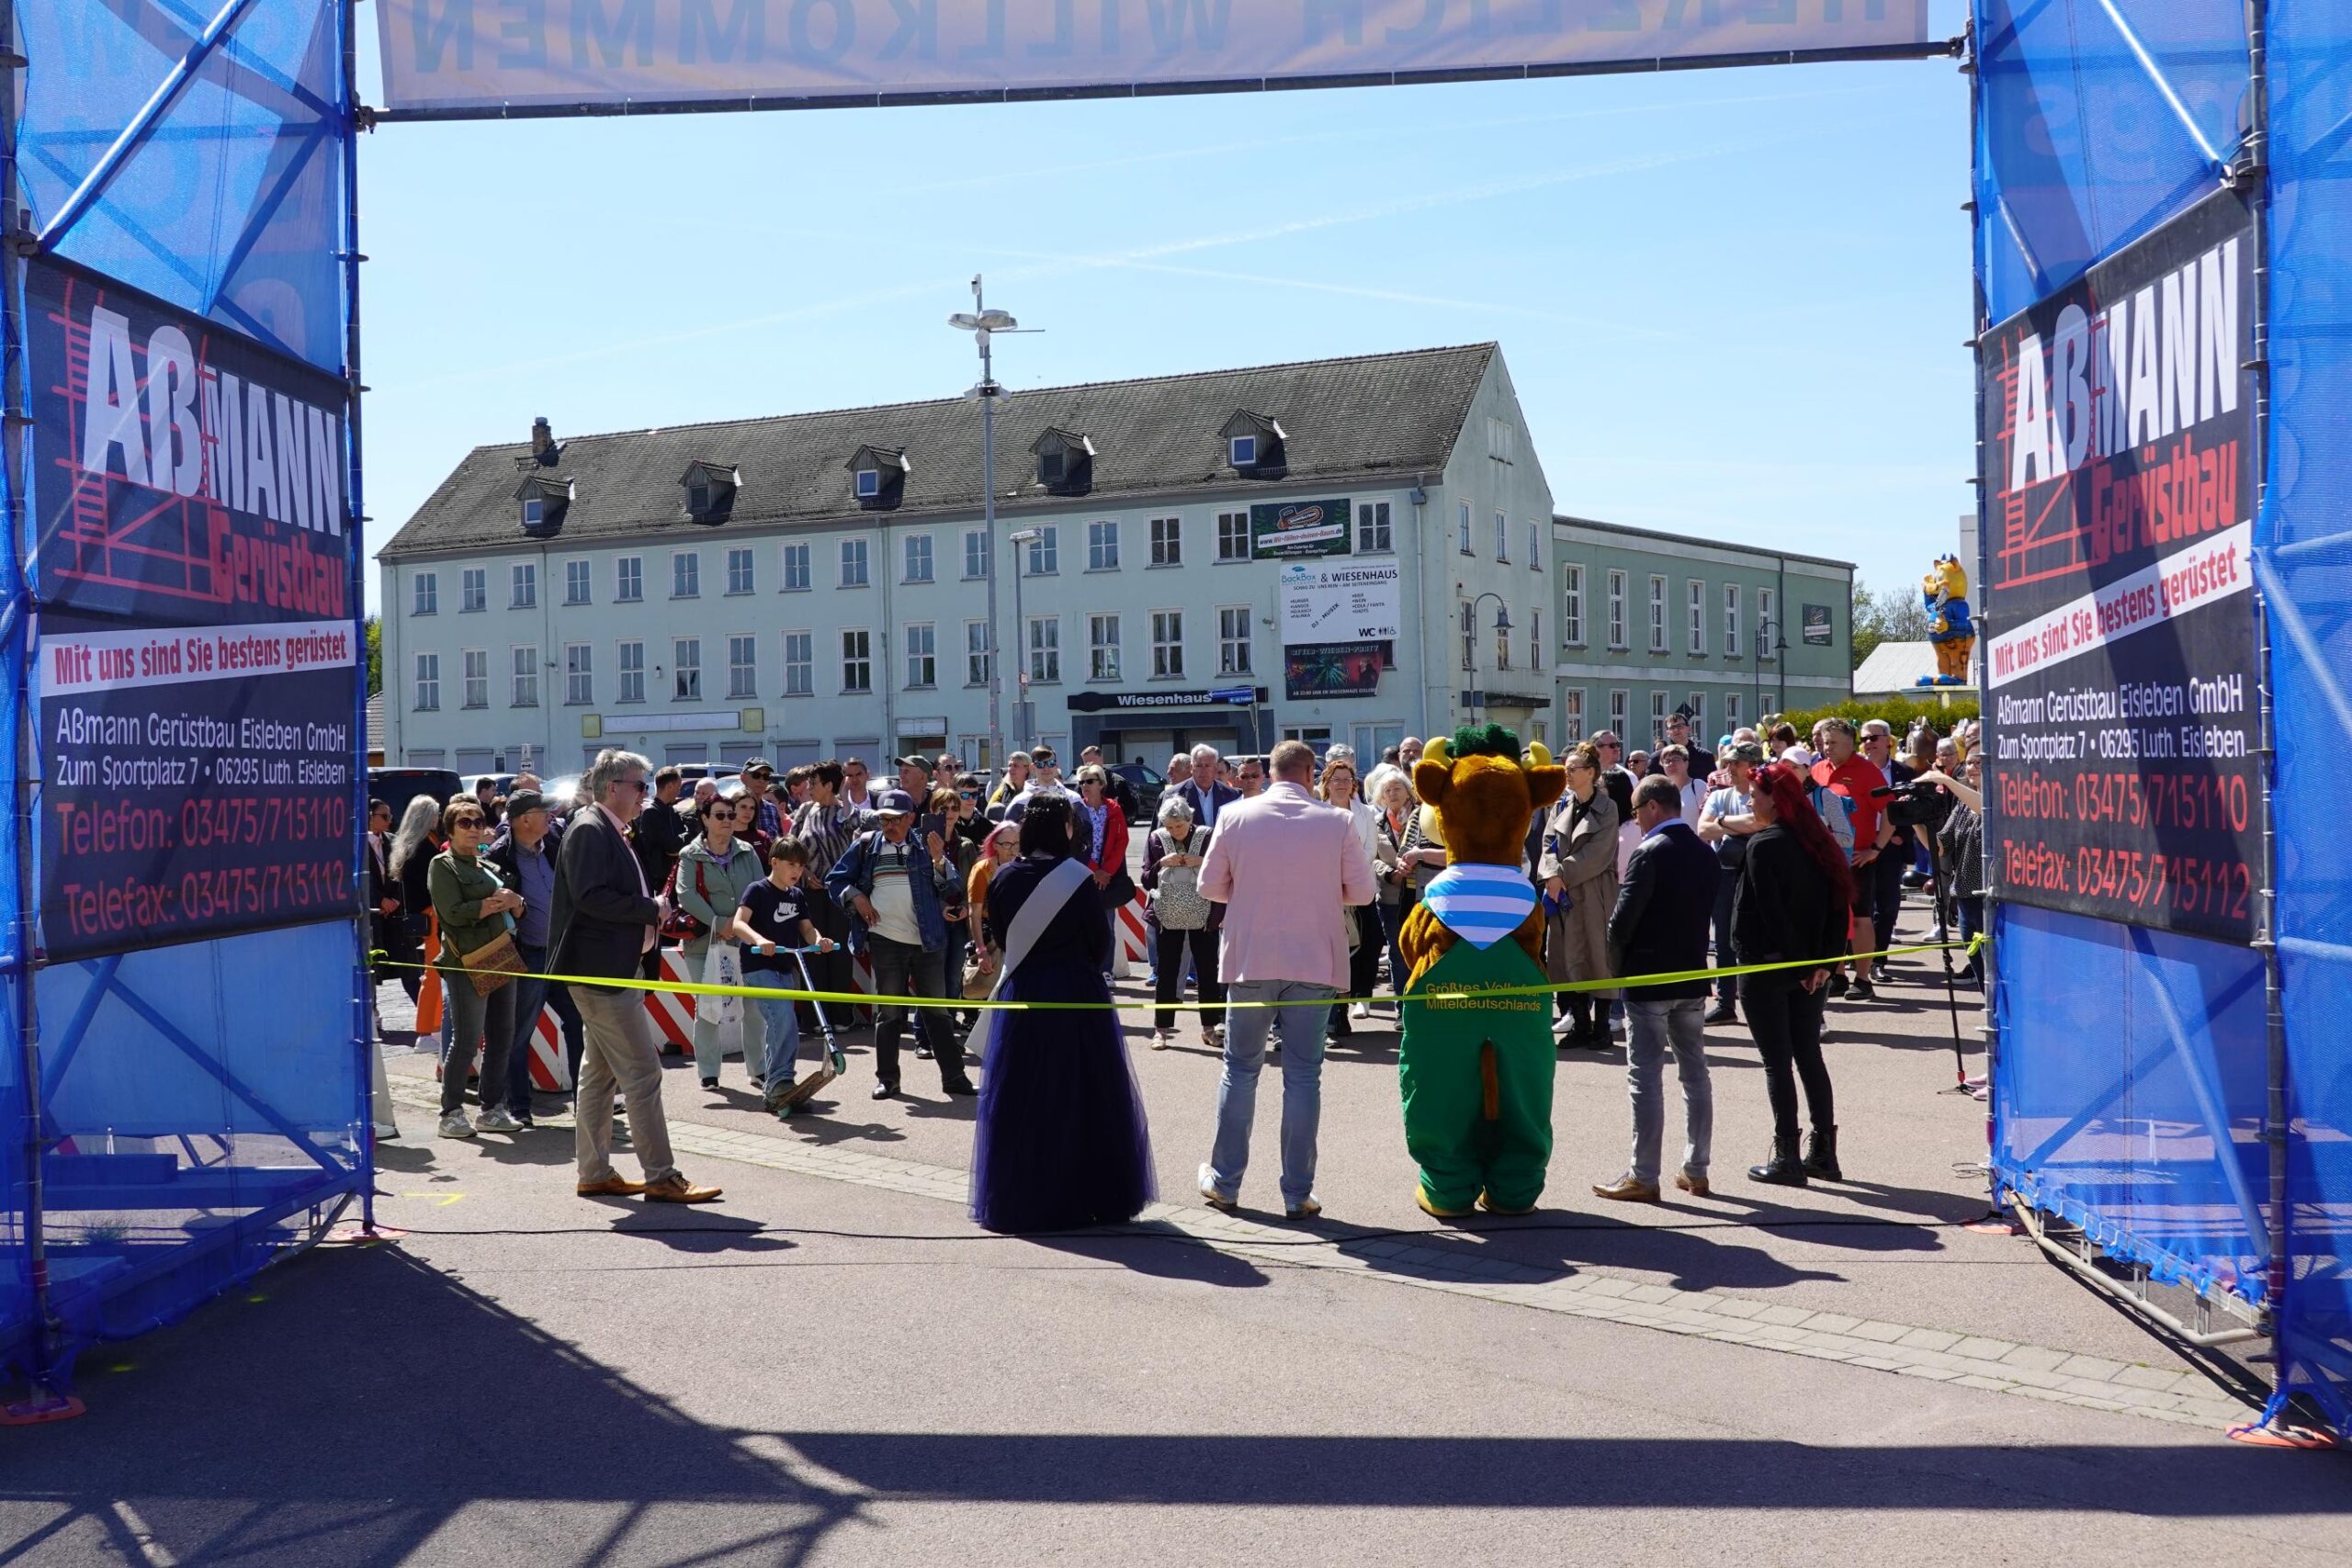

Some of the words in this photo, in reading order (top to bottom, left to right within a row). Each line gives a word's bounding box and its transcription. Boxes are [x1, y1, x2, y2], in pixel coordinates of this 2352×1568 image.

[2092, 433, 2238, 562] Gerüstbau
[210, 509, 344, 618] Gerüstbau
[1320, 573, 1329, 583] &
[1331, 570, 1397, 582] WIESENHAUS
[1321, 603, 1340, 619] MUSIK
[1995, 643, 2014, 678] Mit
[2018, 637, 2039, 671] uns
[2041, 626, 2068, 659] sind
[2073, 608, 2093, 647] Sie
[2097, 585, 2155, 637] bestens
[2160, 541, 2238, 618] gerüstet
[1358, 627, 1375, 637] WC
[55, 644, 92, 684] Mit
[98, 649, 135, 682] uns
[141, 638, 181, 677] sind
[187, 637, 212, 672] Sie
[218, 636, 280, 671] bestens
[286, 629, 346, 670] gerüstet
[1117, 694, 1212, 706] Wiesenhaus
[2047, 686, 2115, 722] Gerüstbau
[2120, 681, 2183, 719] Eisleben
[2188, 673, 2244, 715] GmbH
[147, 712, 234, 749] Gerüstbau
[241, 718, 301, 750] Eisleben
[306, 722, 345, 752] GmbH
[1997, 734, 2019, 761] Zum
[2021, 731, 2075, 763] Sportplatz
[2078, 731, 2086, 760] 7
[2099, 728, 2139, 759] 06295
[2143, 727, 2177, 759] Luth.
[2182, 725, 2245, 758] Eisleben
[56, 755, 96, 786] Zum
[102, 755, 185, 790] Sportplatz
[189, 757, 198, 785] 7
[216, 758, 258, 784] 06295
[263, 758, 294, 785] Luth.
[298, 759, 345, 785] Eisleben
[1998, 772, 2069, 821] Telefon:
[2075, 773, 2247, 833] 03475/715110
[56, 799, 173, 855] Telefon:
[183, 796, 345, 847] 03475/715110
[63, 876, 176, 935] Telefax:
[183, 860, 347, 919] 03475/715112
[2003, 839, 2070, 892] Telefax:
[2077, 847, 2250, 919] 03475/715112
[1426, 981, 1480, 995] Größtes
[1426, 998, 1542, 1011] Mitteldeutschlands
